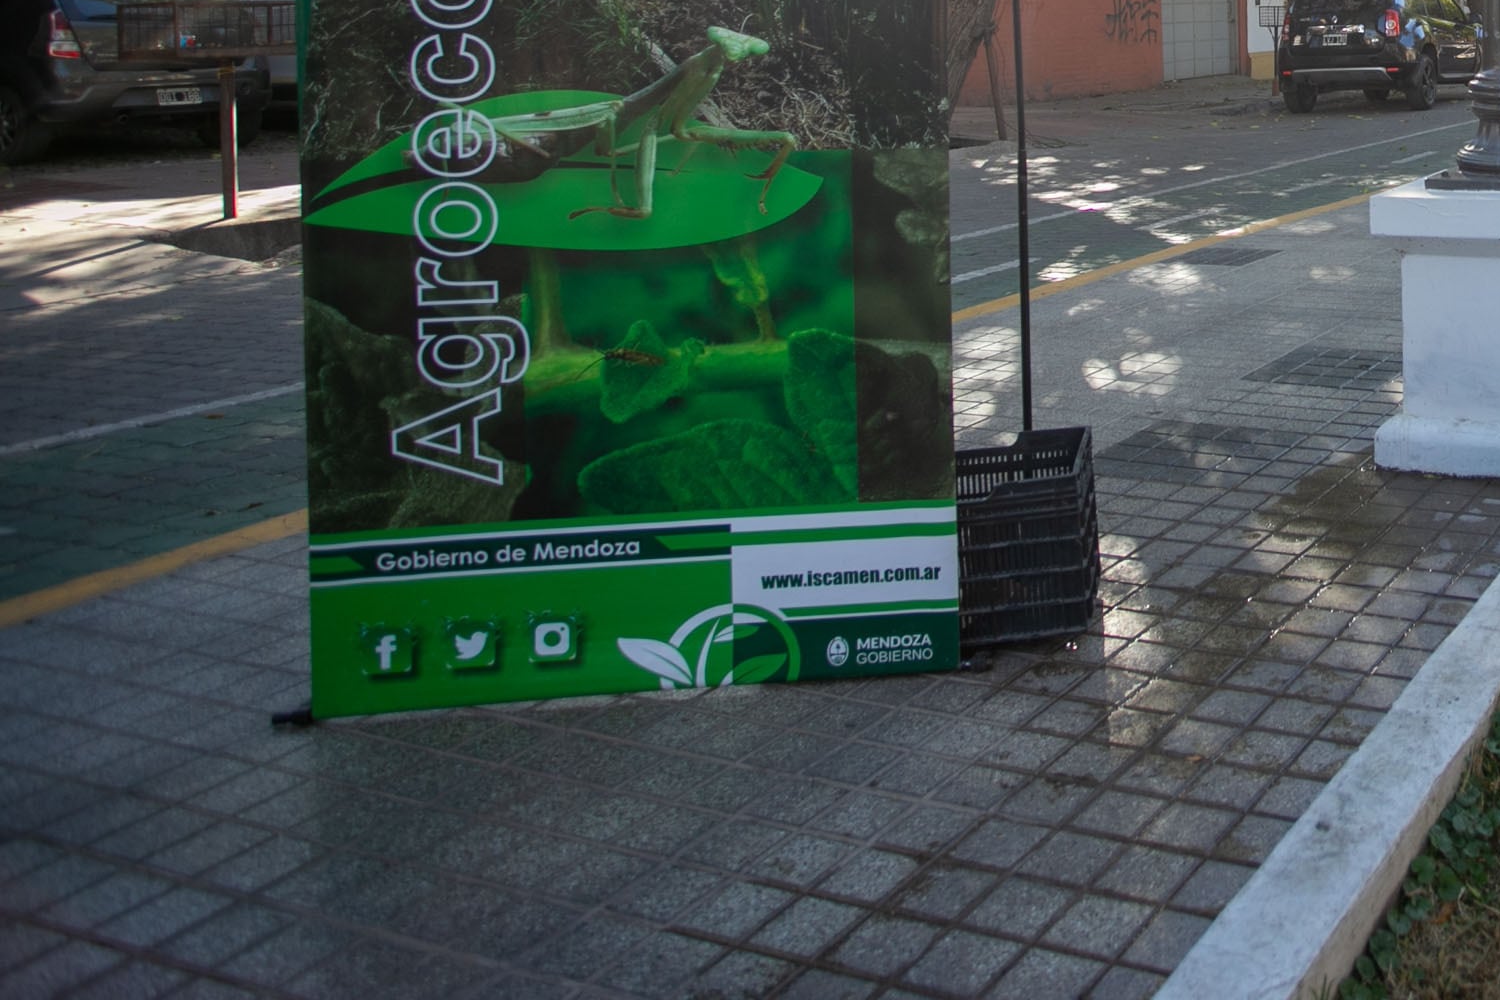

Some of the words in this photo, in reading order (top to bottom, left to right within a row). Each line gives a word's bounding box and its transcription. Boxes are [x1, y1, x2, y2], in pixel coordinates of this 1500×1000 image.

[376, 549, 489, 572] Gobierno
[495, 544, 527, 564] de
[533, 539, 641, 562] Mendoza
[761, 565, 942, 590] www.iscamen.com.ar
[856, 633, 933, 650] MENDOZA
[856, 647, 934, 665] GOBIERNO
